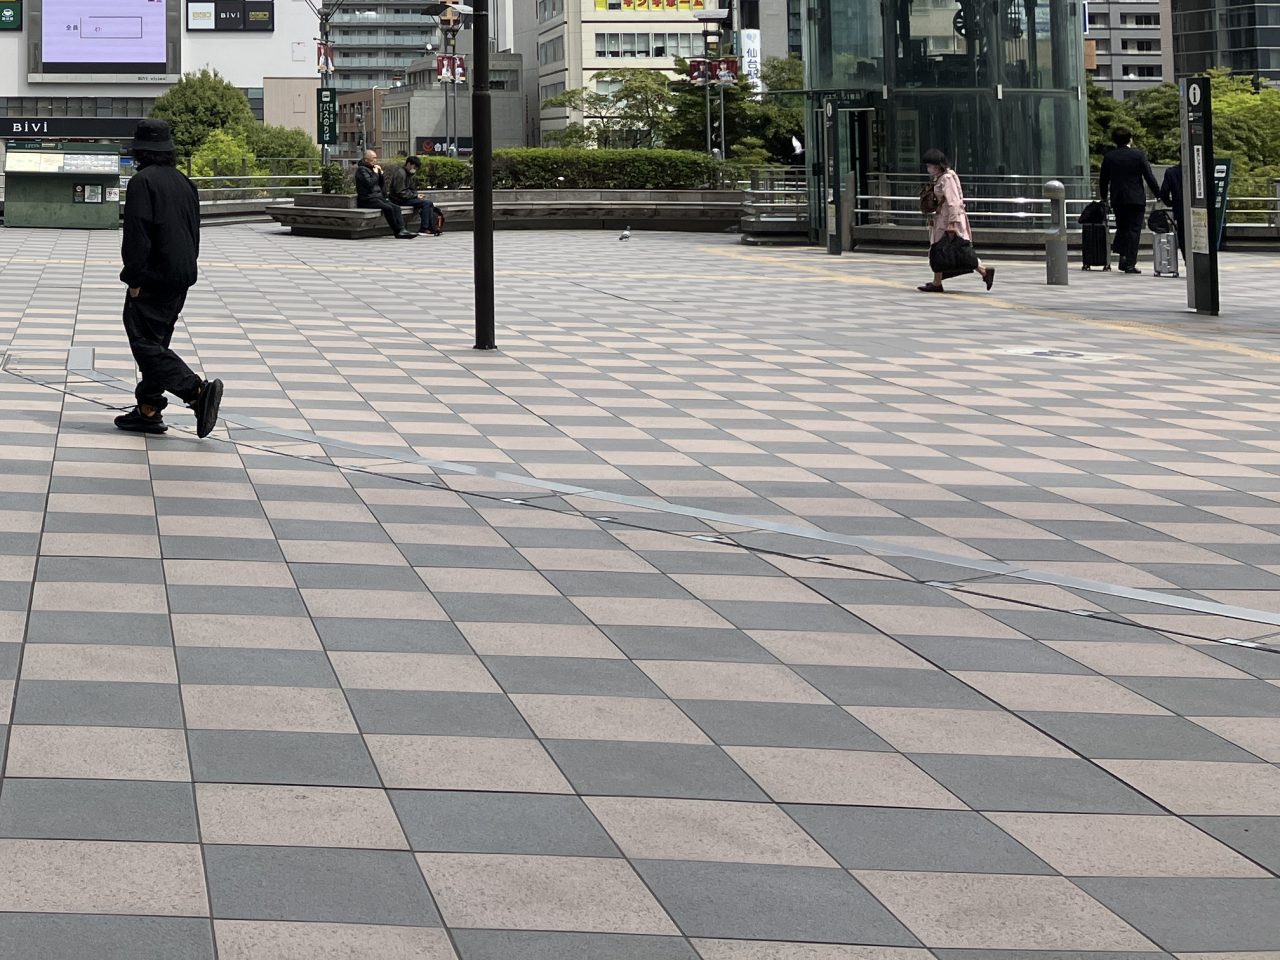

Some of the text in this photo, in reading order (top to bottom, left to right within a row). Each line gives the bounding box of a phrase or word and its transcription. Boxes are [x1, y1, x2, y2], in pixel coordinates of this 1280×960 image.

[12, 121, 49, 133] BiVi
[322, 103, 330, 141] バスのりば
